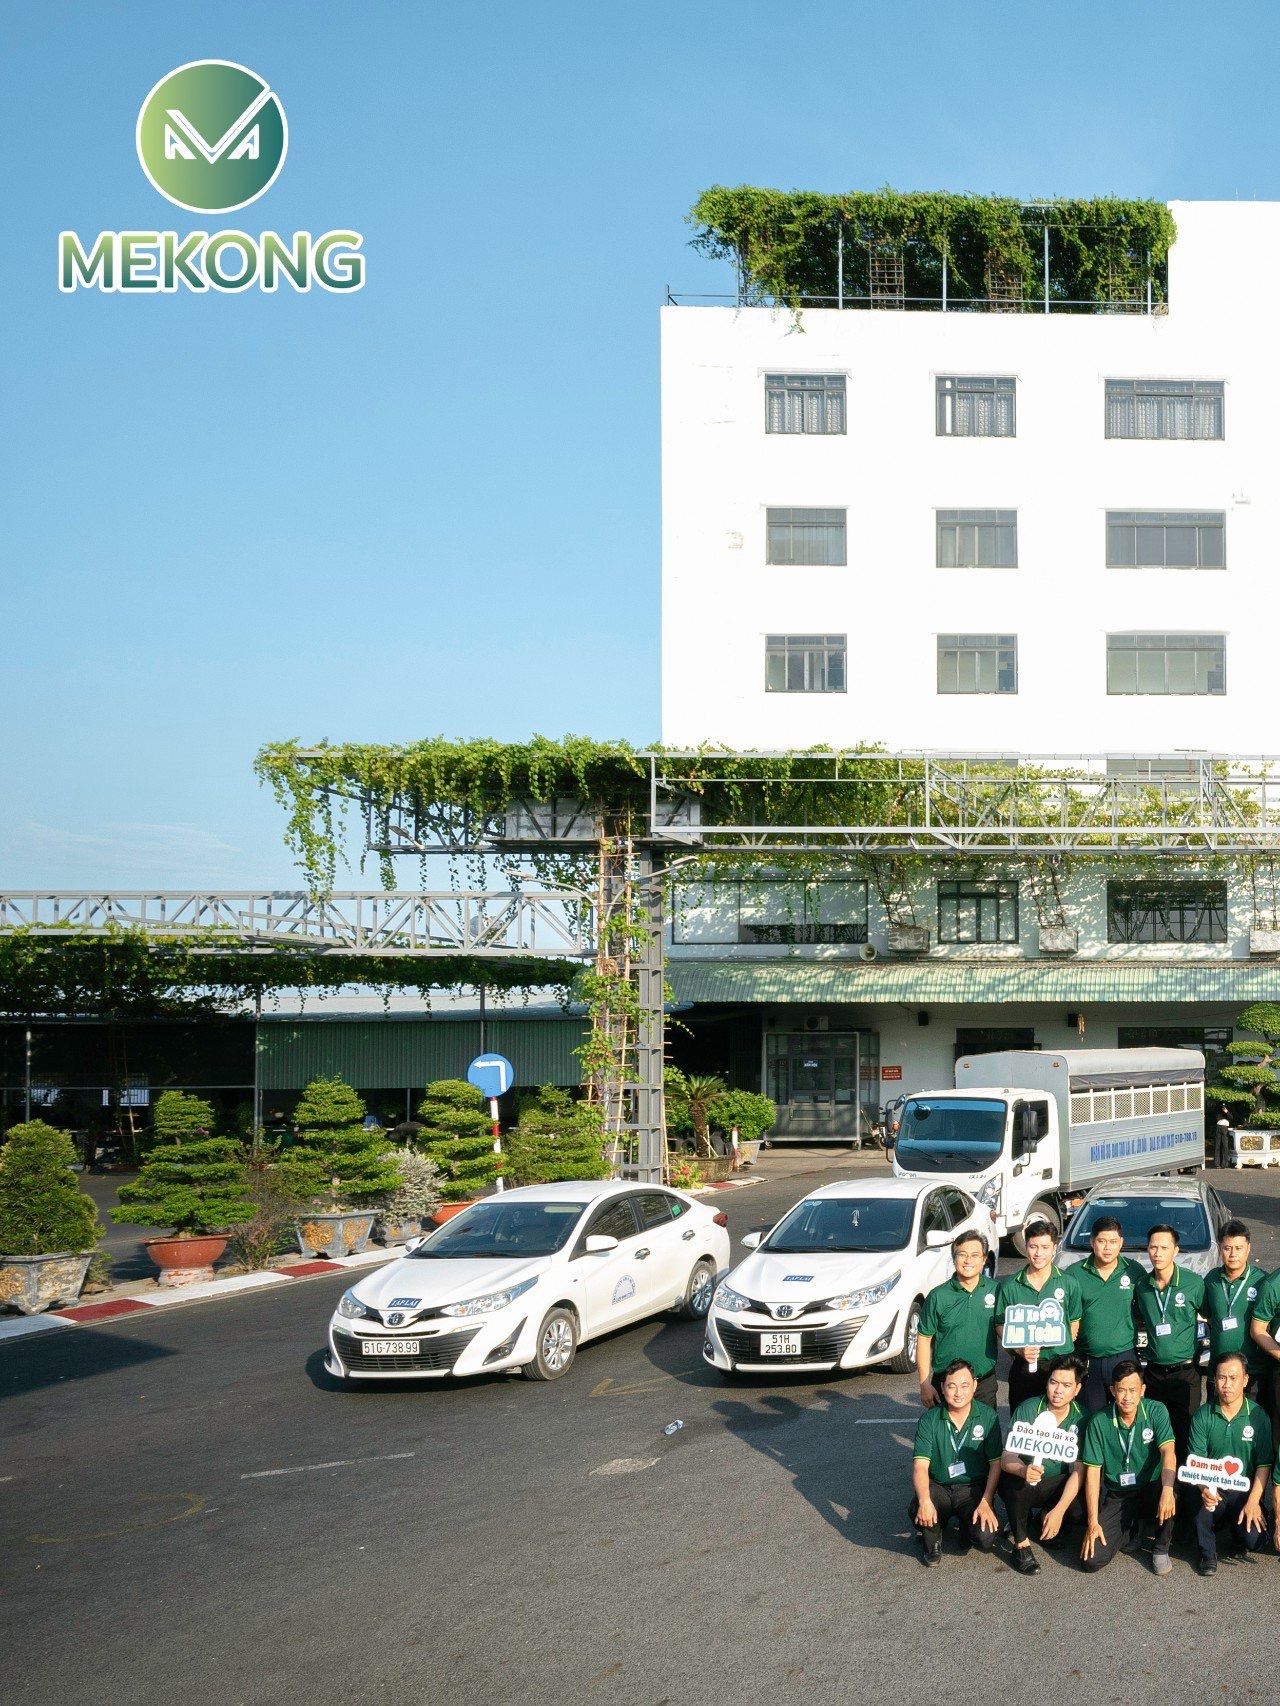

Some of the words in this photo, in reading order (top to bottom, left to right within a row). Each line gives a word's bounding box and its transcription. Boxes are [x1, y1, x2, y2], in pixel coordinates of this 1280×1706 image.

[772, 1334, 790, 1344] 51H
[364, 1342, 418, 1354] 51G-738.99
[765, 1344, 797, 1354] 253.80
[1010, 1435, 1075, 1458] MEKONG
